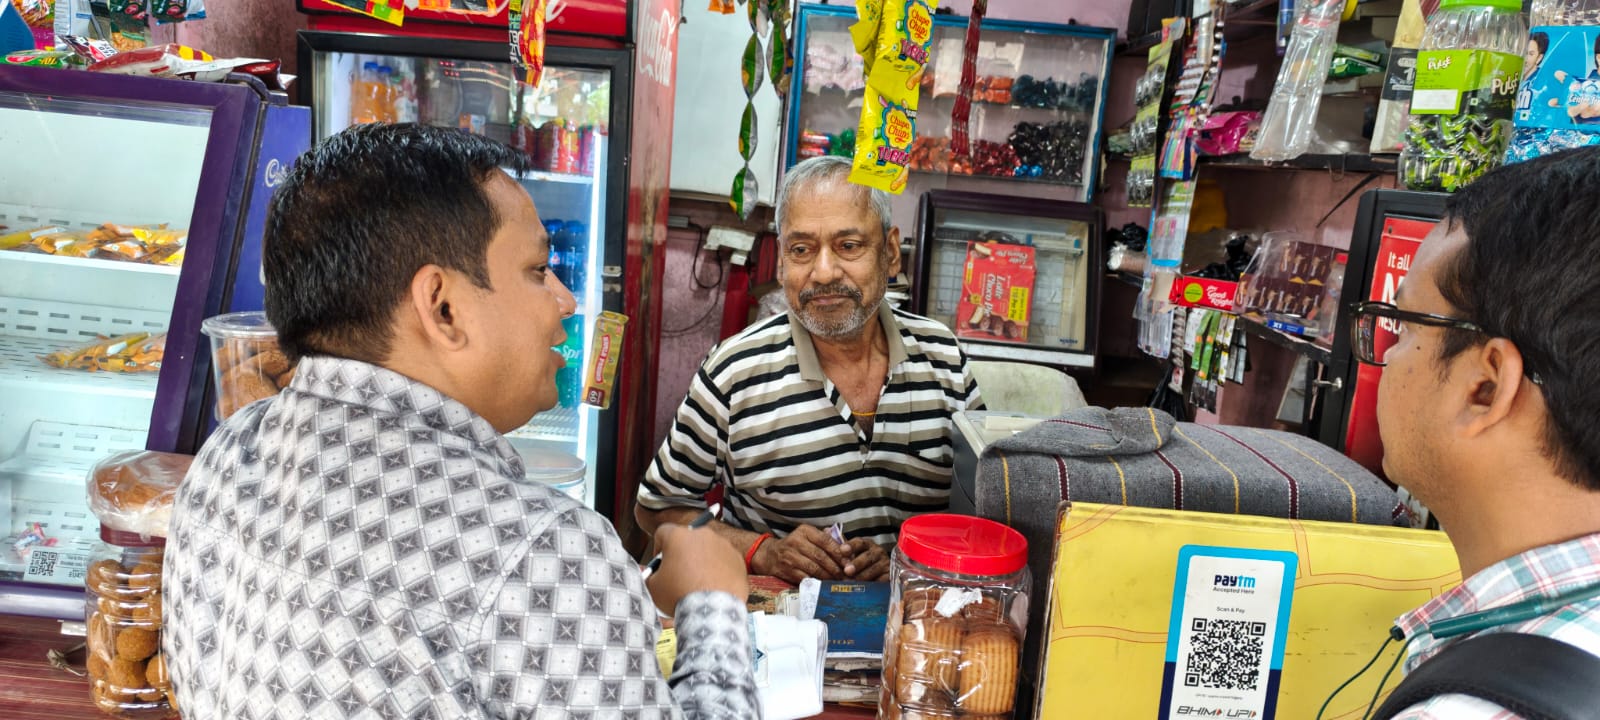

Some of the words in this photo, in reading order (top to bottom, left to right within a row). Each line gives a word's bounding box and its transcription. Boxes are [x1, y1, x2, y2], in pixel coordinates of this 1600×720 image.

[911, 9, 930, 27] Chupa
[909, 19, 928, 36] Chups
[889, 115, 910, 129] Chupa
[888, 124, 909, 139] Chups
[1388, 252, 1396, 268] It
[1397, 254, 1410, 271] all
[985, 273, 996, 301] Choco
[1213, 574, 1256, 588] paytm
[1213, 586, 1240, 595] Accepted
[1235, 607, 1245, 615] Pay
[1177, 705, 1217, 717] BHIM
[1226, 709, 1253, 718] UPI
